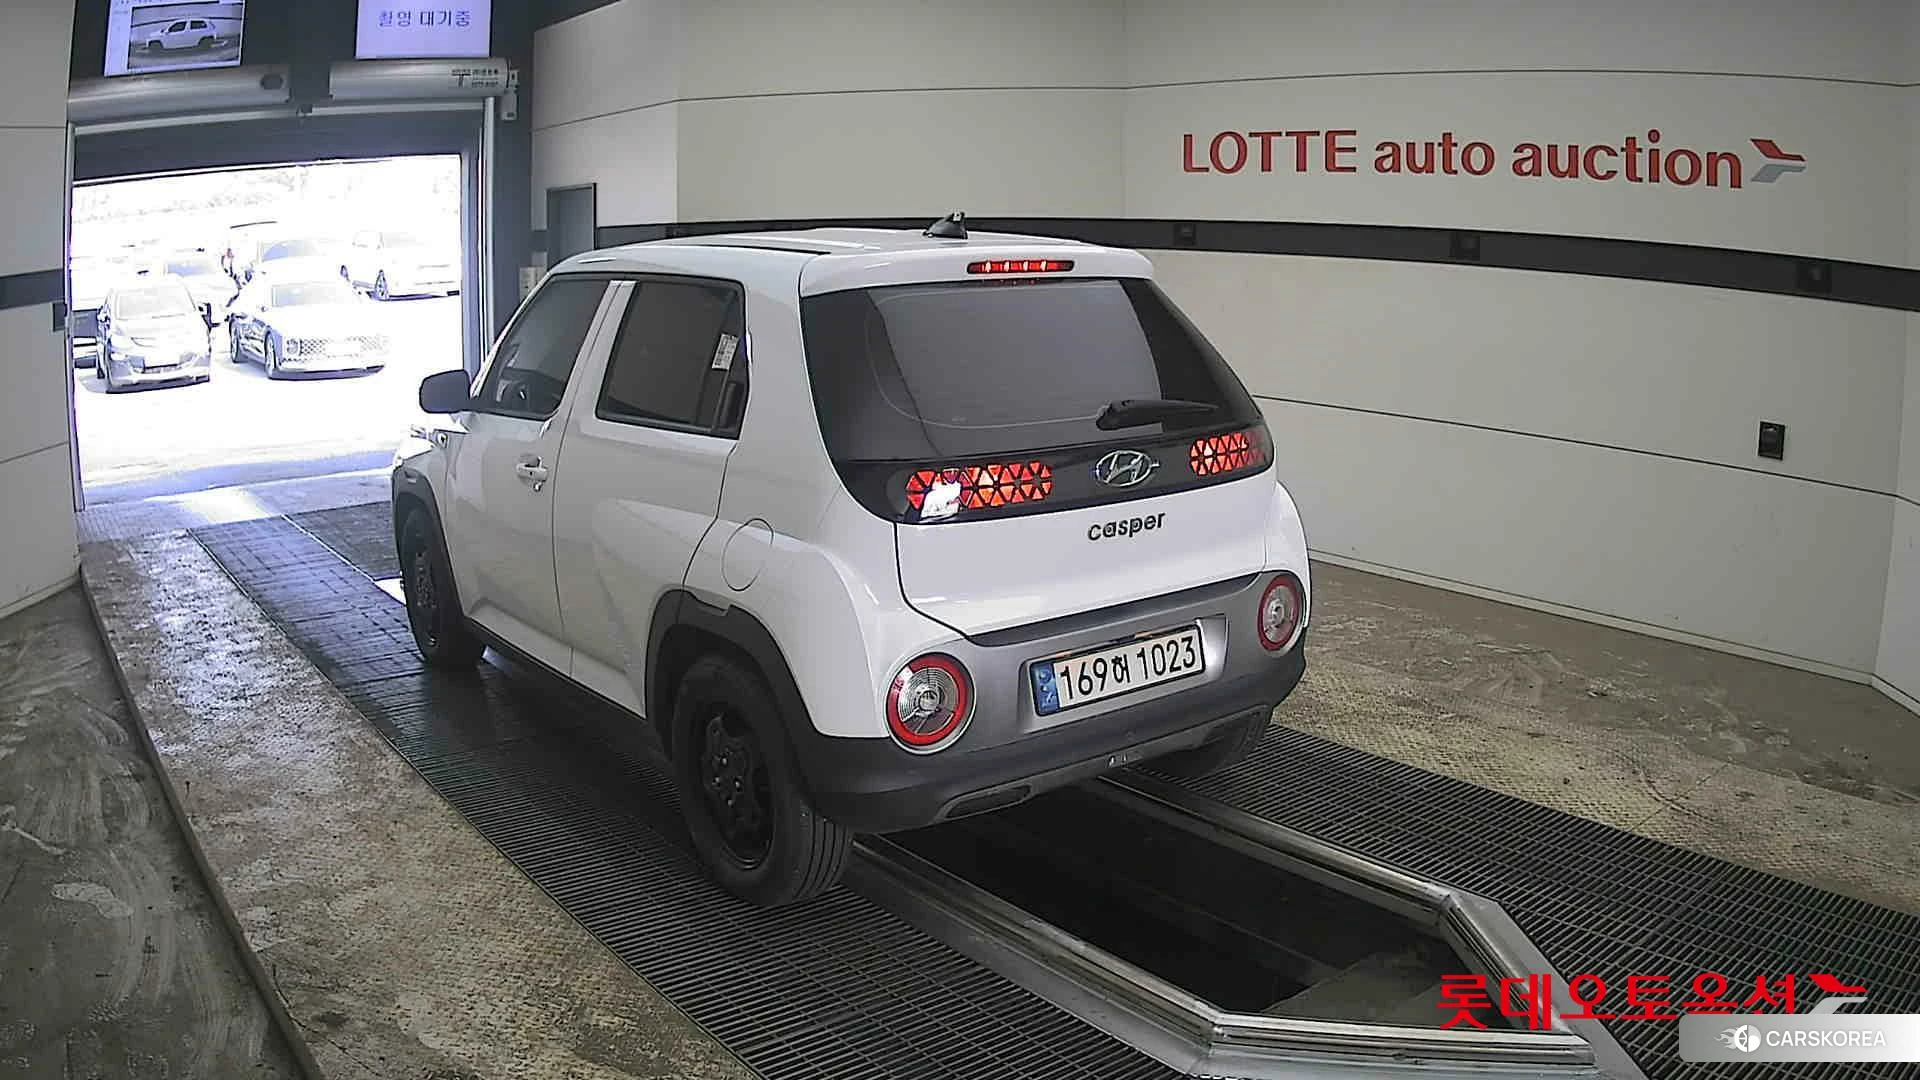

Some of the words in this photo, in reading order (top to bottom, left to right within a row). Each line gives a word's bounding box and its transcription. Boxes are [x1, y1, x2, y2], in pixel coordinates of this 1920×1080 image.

[420, 11, 471, 27] 대기중
[1183, 130, 1357, 174] LOTTE
[1374, 131, 1495, 177] auto
[1511, 129, 1743, 189] auction
[1088, 513, 1166, 540] casper
[1060, 653, 1130, 699] 169허
[1137, 636, 1195, 680] 1023
